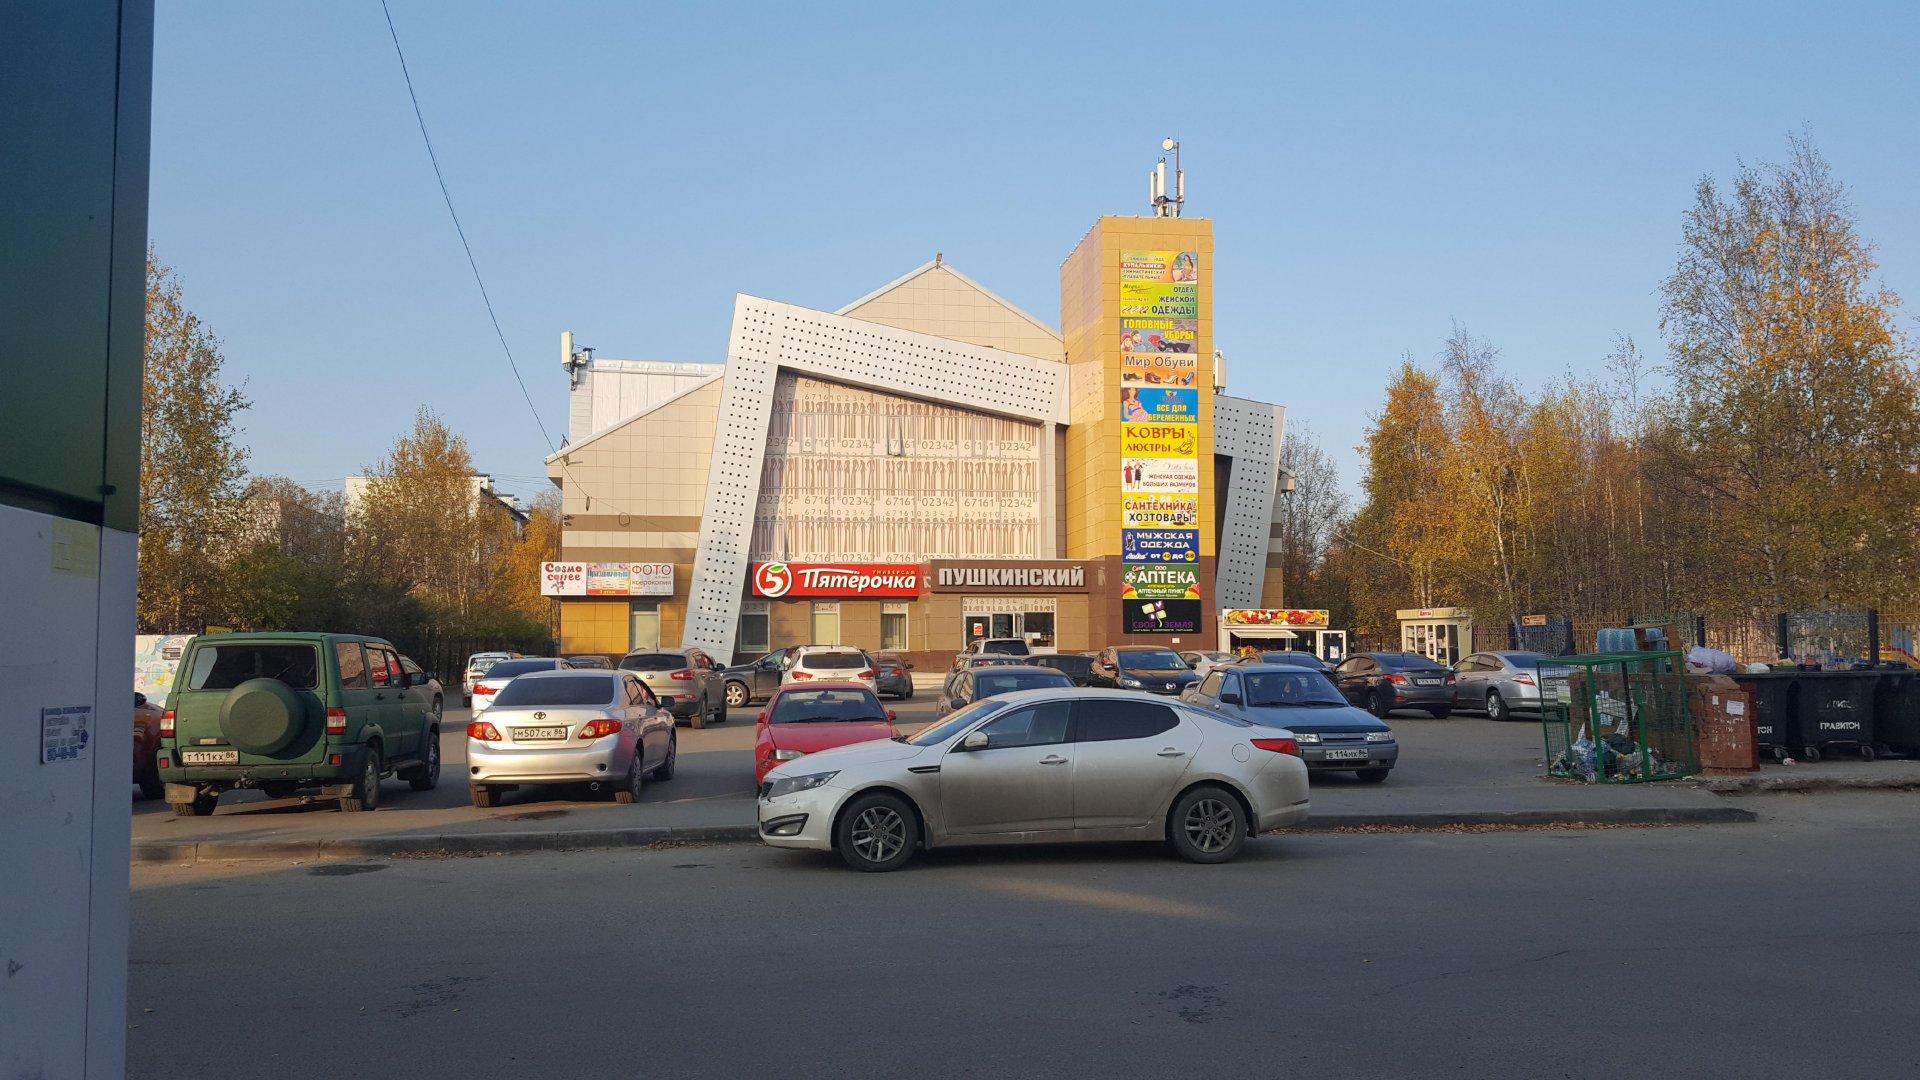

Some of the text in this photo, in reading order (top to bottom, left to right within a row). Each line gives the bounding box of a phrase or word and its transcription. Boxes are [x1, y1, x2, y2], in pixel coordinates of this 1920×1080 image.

[1151, 305, 1195, 315] ОДЕЖДЫ
[1124, 319, 1174, 329] ГОЛОВНЫЕ
[1164, 330, 1194, 339] УБОРЫ
[1125, 355, 1194, 369] Мир Обуви
[1156, 404, 1187, 412] ВСЕ ДЛЯ
[1125, 427, 1185, 439] КОВРЫ
[921, 441, 954, 450] 02342
[999, 443, 1032, 451] 02342
[1125, 443, 1171, 452] ЛЮСТРЫ
[921, 497, 955, 507] 02342
[964, 499, 995, 507] 67161
[1000, 499, 1033, 508] 02342
[1125, 501, 1193, 510] САНТЕХНИКА
[1129, 513, 1192, 522] ХОЗТОВАРЫ
[1136, 532, 1193, 540] МУЖСКАЯ
[1140, 541, 1190, 549] ОДЕЖДА
[632, 564, 672, 576] ФОТО
[938, 566, 1085, 586] ПУШКИНСКИЙ
[1136, 571, 1197, 584] АПТЕКА
[1132, 621, 1156, 629] СВОЯ
[1164, 621, 1194, 629] ЗЕМЛЯ
[1819, 721, 1861, 730] ГРАВИТОН
